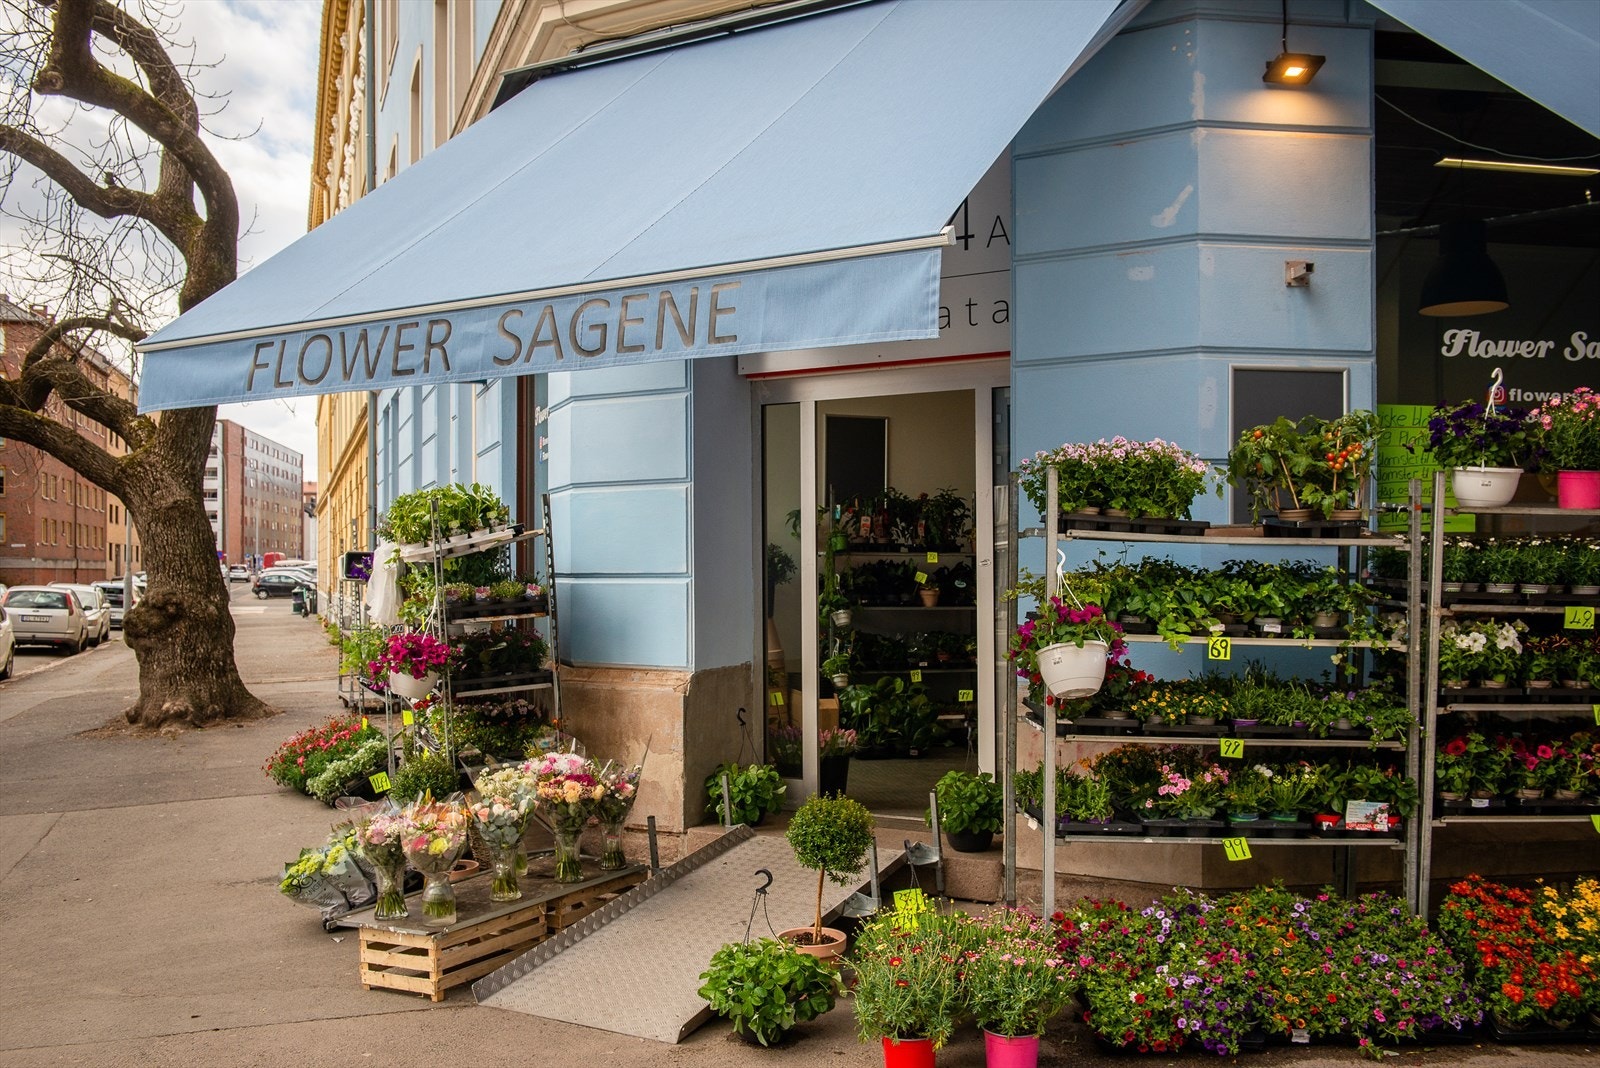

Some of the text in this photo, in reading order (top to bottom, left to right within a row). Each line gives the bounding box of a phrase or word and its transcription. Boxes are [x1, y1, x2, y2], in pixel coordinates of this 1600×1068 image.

[246, 281, 742, 392] FLOWER SAGENE
[1441, 329, 1555, 358] Flower
[1211, 639, 1228, 657] 69
[1224, 740, 1240, 755] 99
[371, 775, 389, 790] 149
[1224, 838, 1246, 858] 99
